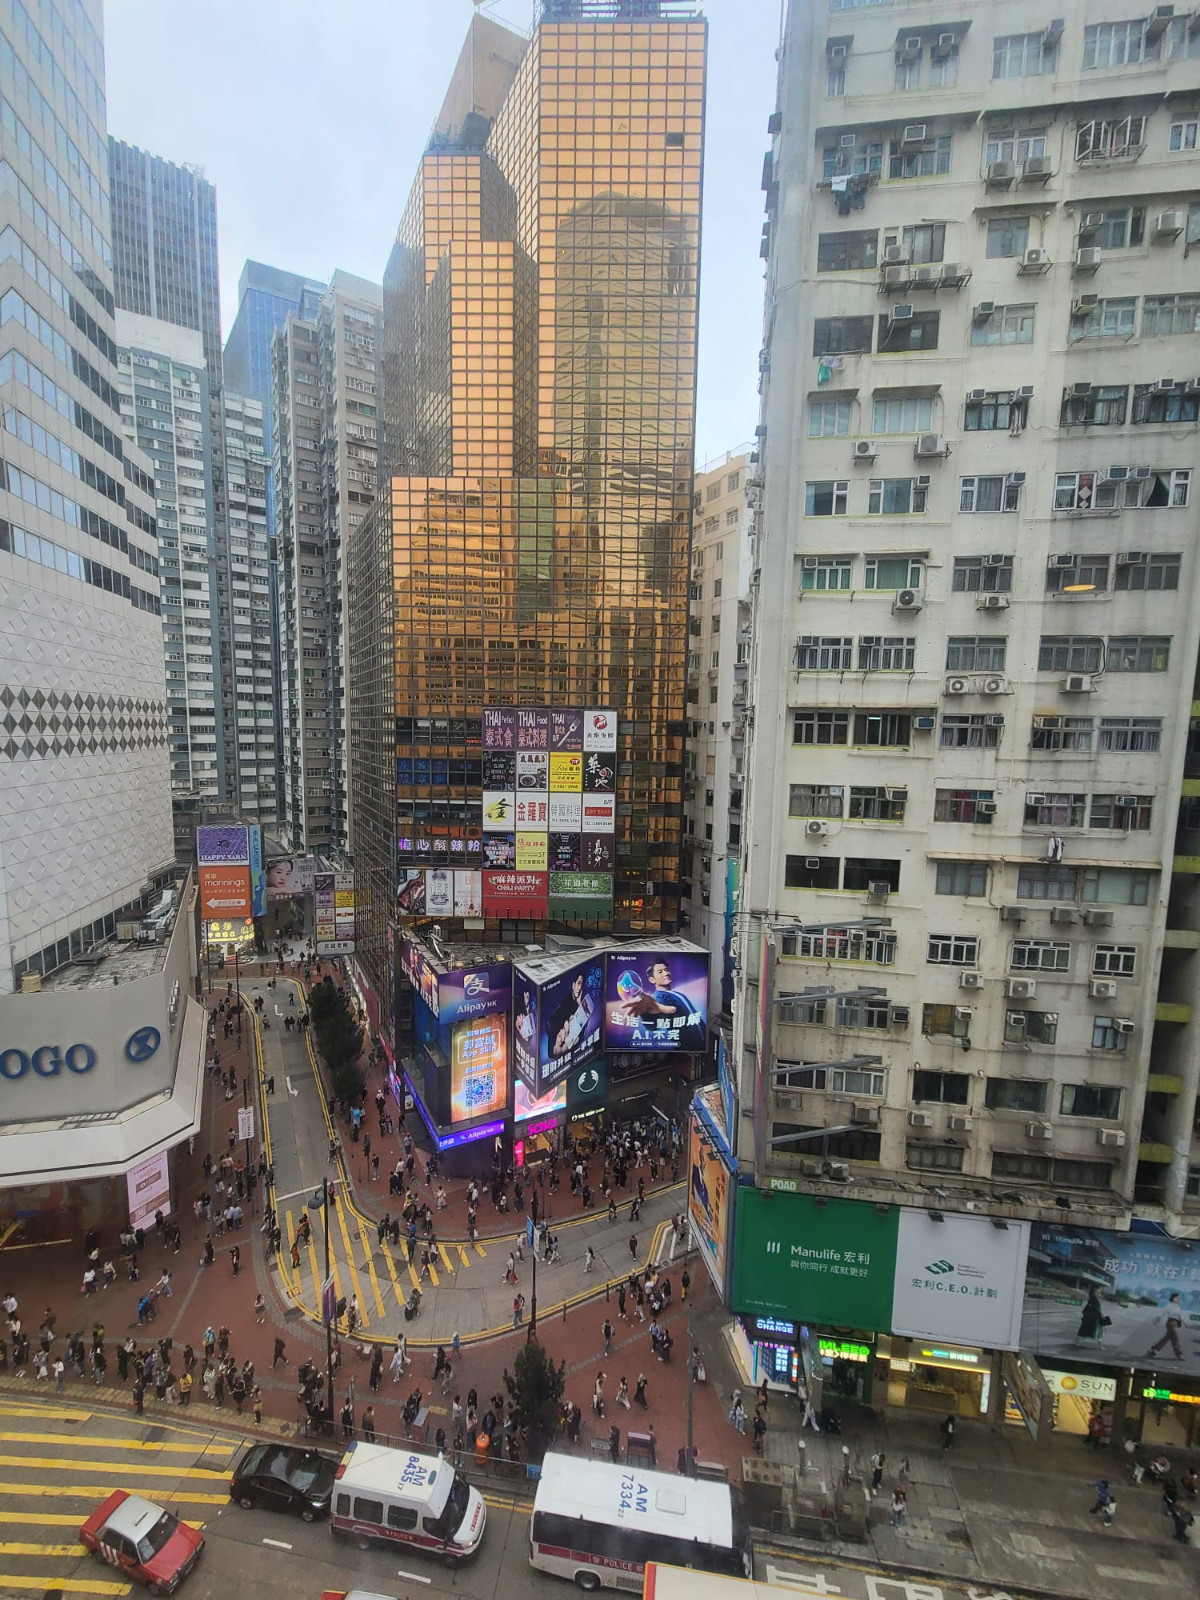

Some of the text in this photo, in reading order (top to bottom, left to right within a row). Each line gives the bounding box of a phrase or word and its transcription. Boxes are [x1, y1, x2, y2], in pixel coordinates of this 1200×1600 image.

[485, 711, 501, 726] THAI
[518, 712, 547, 727] THAI Food
[552, 714, 564, 724] THAI
[205, 879, 245, 887] mannings
[611, 1011, 701, 1029] 生活一點即解
[462, 1051, 478, 1059] App
[770, 1179, 796, 1191] POAD
[791, 1245, 870, 1265] Manulife 宏利
[791, 1259, 868, 1278] 與你同行 成就更好
[1103, 1259, 1138, 1275] 成功
[912, 1278, 998, 1298] 宏利C.E.O.計劃
[756, 1323, 794, 1334] CHANGE
[1081, 1379, 1114, 1392] SUN
[400, 1455, 420, 1483] 8435
[411, 1466, 427, 1487] AM
[618, 1474, 634, 1519] 7334 22
[635, 1483, 648, 1513] AM
[604, 1559, 633, 1571] POLICE
